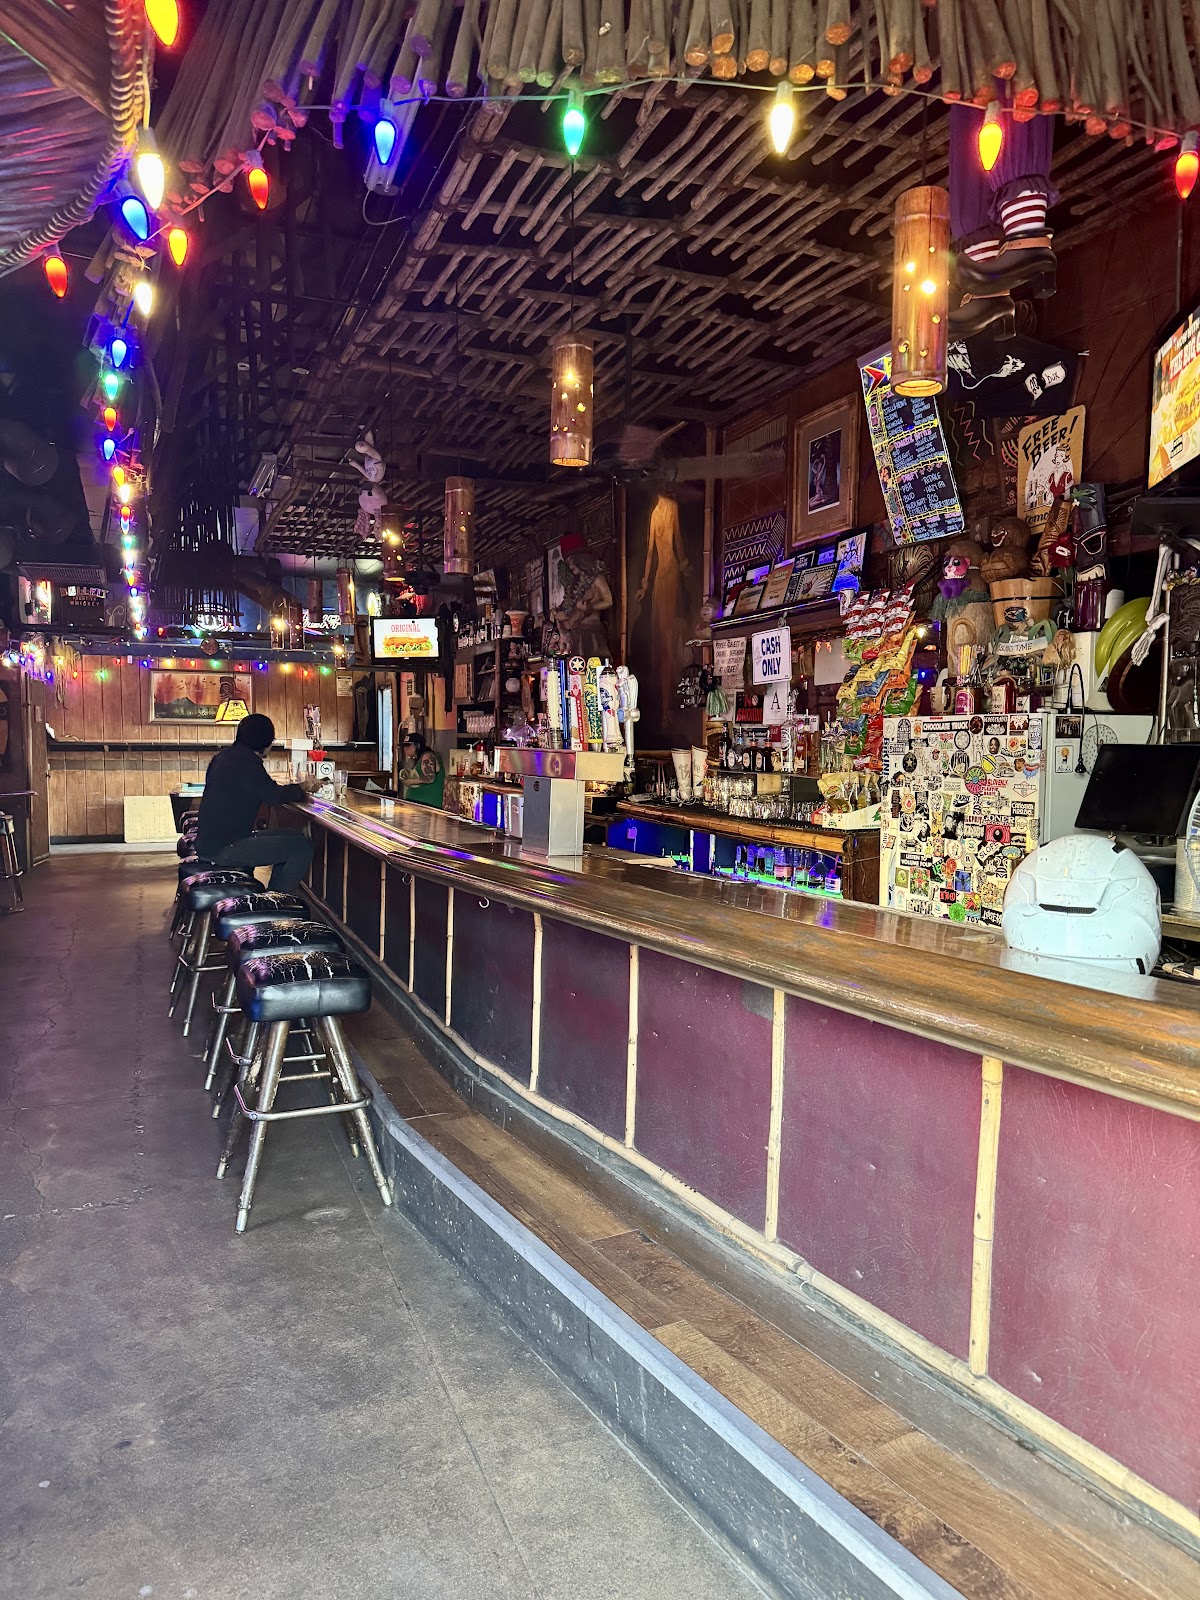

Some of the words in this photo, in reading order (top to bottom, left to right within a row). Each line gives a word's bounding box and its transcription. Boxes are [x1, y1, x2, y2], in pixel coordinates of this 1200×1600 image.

[1021, 415, 1060, 461] FREE
[1031, 415, 1079, 470] BEER!
[391, 623, 421, 633] ORIGINAL
[761, 635, 781, 656] CASH
[1014, 642, 1033, 652] TIME
[762, 656, 782, 677] ONLY
[744, 694, 759, 707] NO
[770, 690, 781, 710] A
[923, 722, 951, 731] CHOCOLATE
[951, 721, 969, 730] TRUCK
[987, 779, 1009, 787] SLOVENLY
[983, 814, 1015, 824] GONER
[979, 840, 1000, 859] SLOPE
[905, 853, 921, 861] LISTEN
[901, 859, 919, 867] VOLUME
